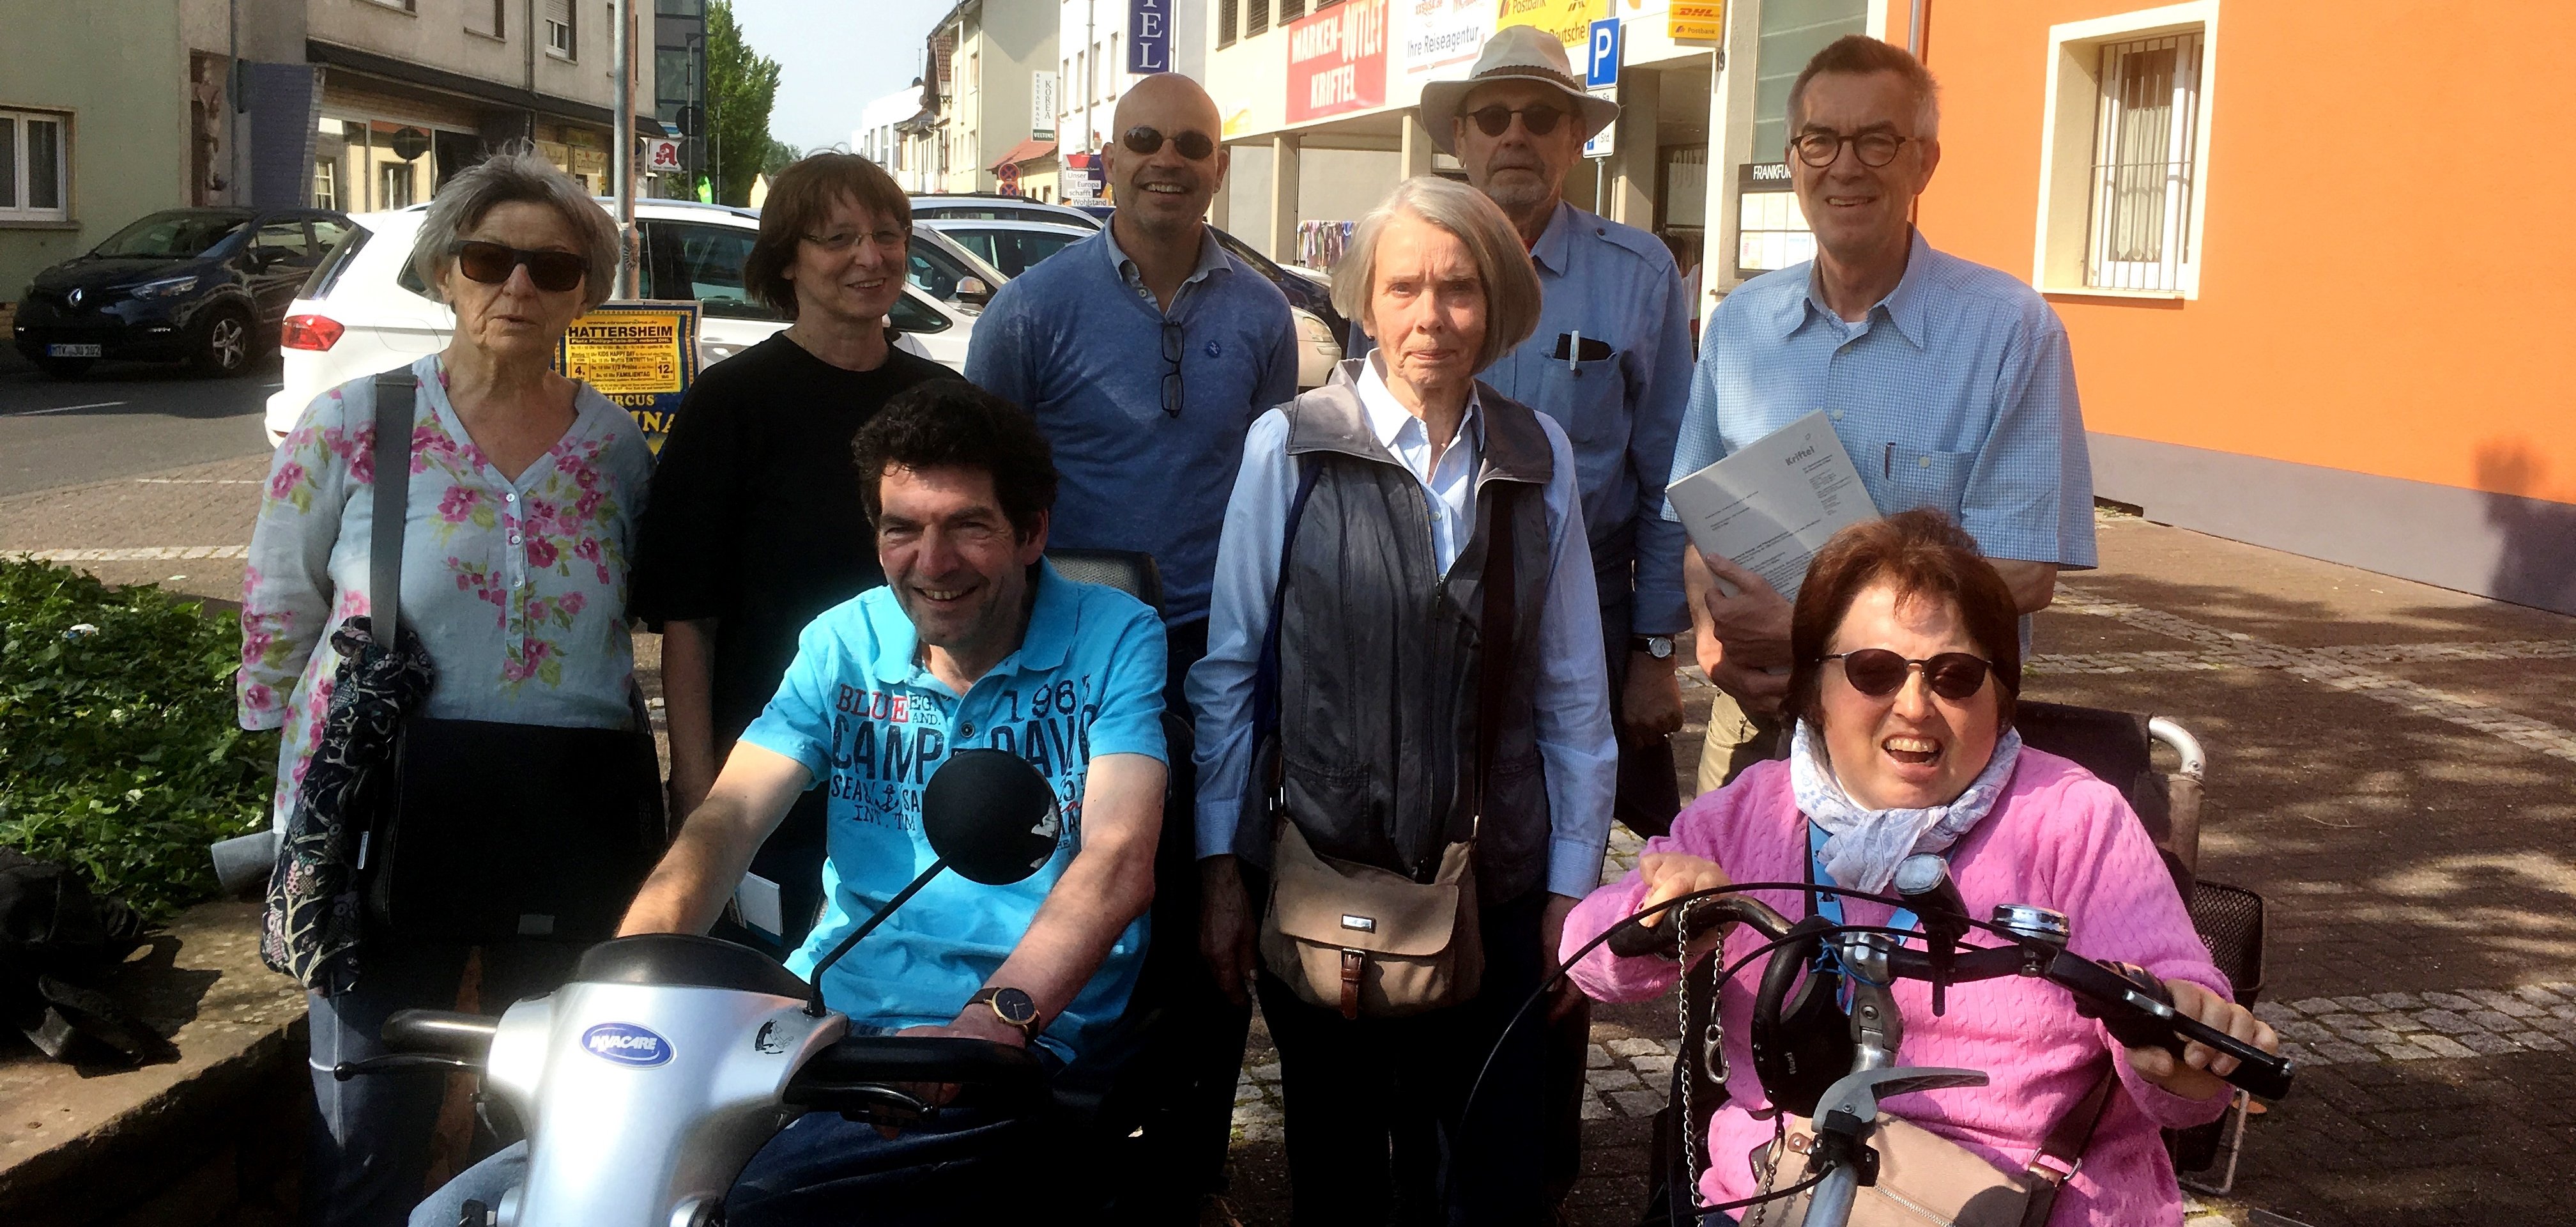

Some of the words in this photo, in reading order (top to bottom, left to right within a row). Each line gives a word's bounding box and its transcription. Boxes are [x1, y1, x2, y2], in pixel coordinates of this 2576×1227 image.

[1679, 8, 1713, 17] DHL
[1407, 40, 1422, 58] Ihre
[1424, 26, 1479, 53] Reiseagentur
[1593, 27, 1613, 78] P
[1716, 51, 1725, 72] 19
[1310, 64, 1356, 109] KRIFTEL
[568, 326, 673, 337] HATTERSHEIM
[574, 366, 585, 375] 4.
[657, 364, 673, 374] 12.
[1784, 445, 1815, 466] Kriftel
[836, 683, 909, 723] BLUE
[912, 713, 941, 725] AND.
[831, 713, 944, 785] CAMP
[589, 1035, 657, 1052] INVACARE
